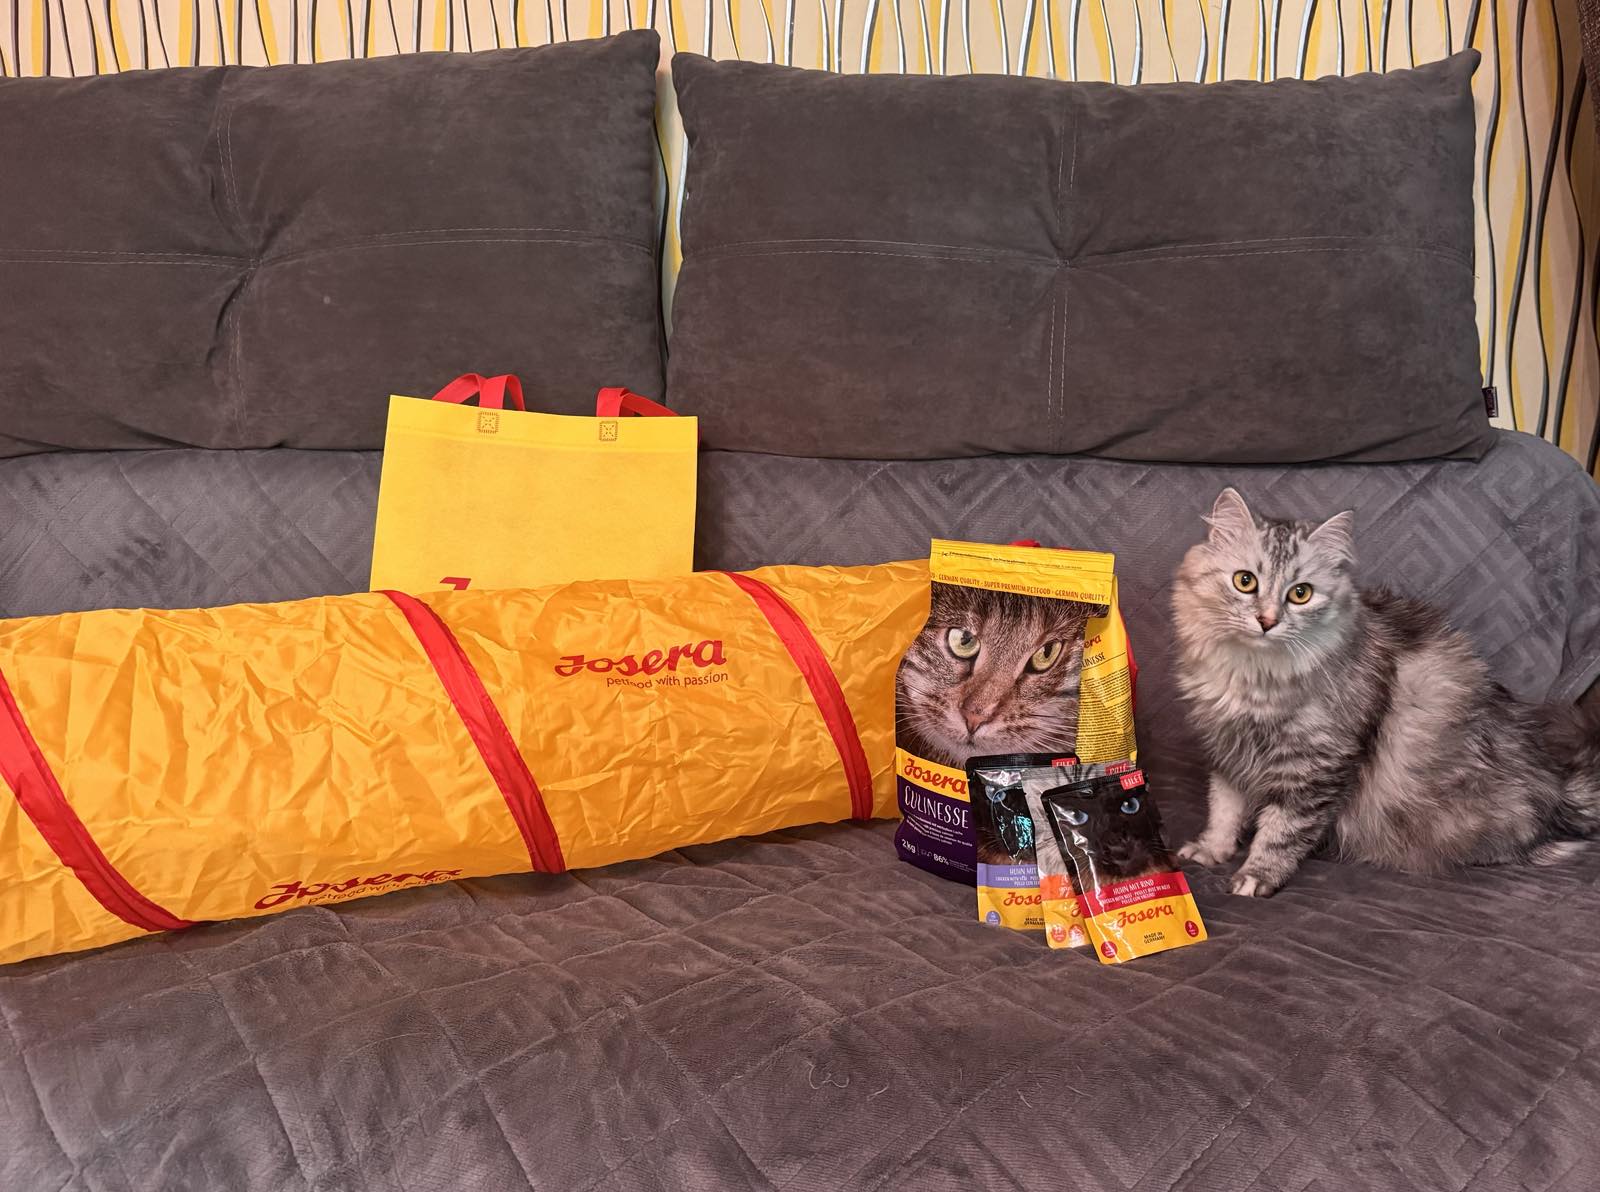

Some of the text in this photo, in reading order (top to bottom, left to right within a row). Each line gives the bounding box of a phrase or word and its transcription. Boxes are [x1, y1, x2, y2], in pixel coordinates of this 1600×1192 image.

[938, 573, 959, 583] GERMAN
[959, 576, 980, 586] QUALITY
[984, 580, 1051, 595] SUPER PREMIUM PETFOOD
[1055, 589, 1106, 601] GERMAN QUALITY
[554, 639, 727, 678] Josera
[655, 674, 681, 687] with
[684, 671, 729, 688] passion
[904, 757, 967, 795] Josera
[1124, 774, 1143, 787] FILET
[904, 785, 969, 829] CULINESSE
[933, 853, 950, 866] 86%
[254, 868, 463, 910] Josera
[1129, 882, 1141, 891] MIT
[1116, 904, 1174, 928] Josera
[1143, 931, 1157, 940] MADE
[1143, 935, 1165, 945] GERMANY
